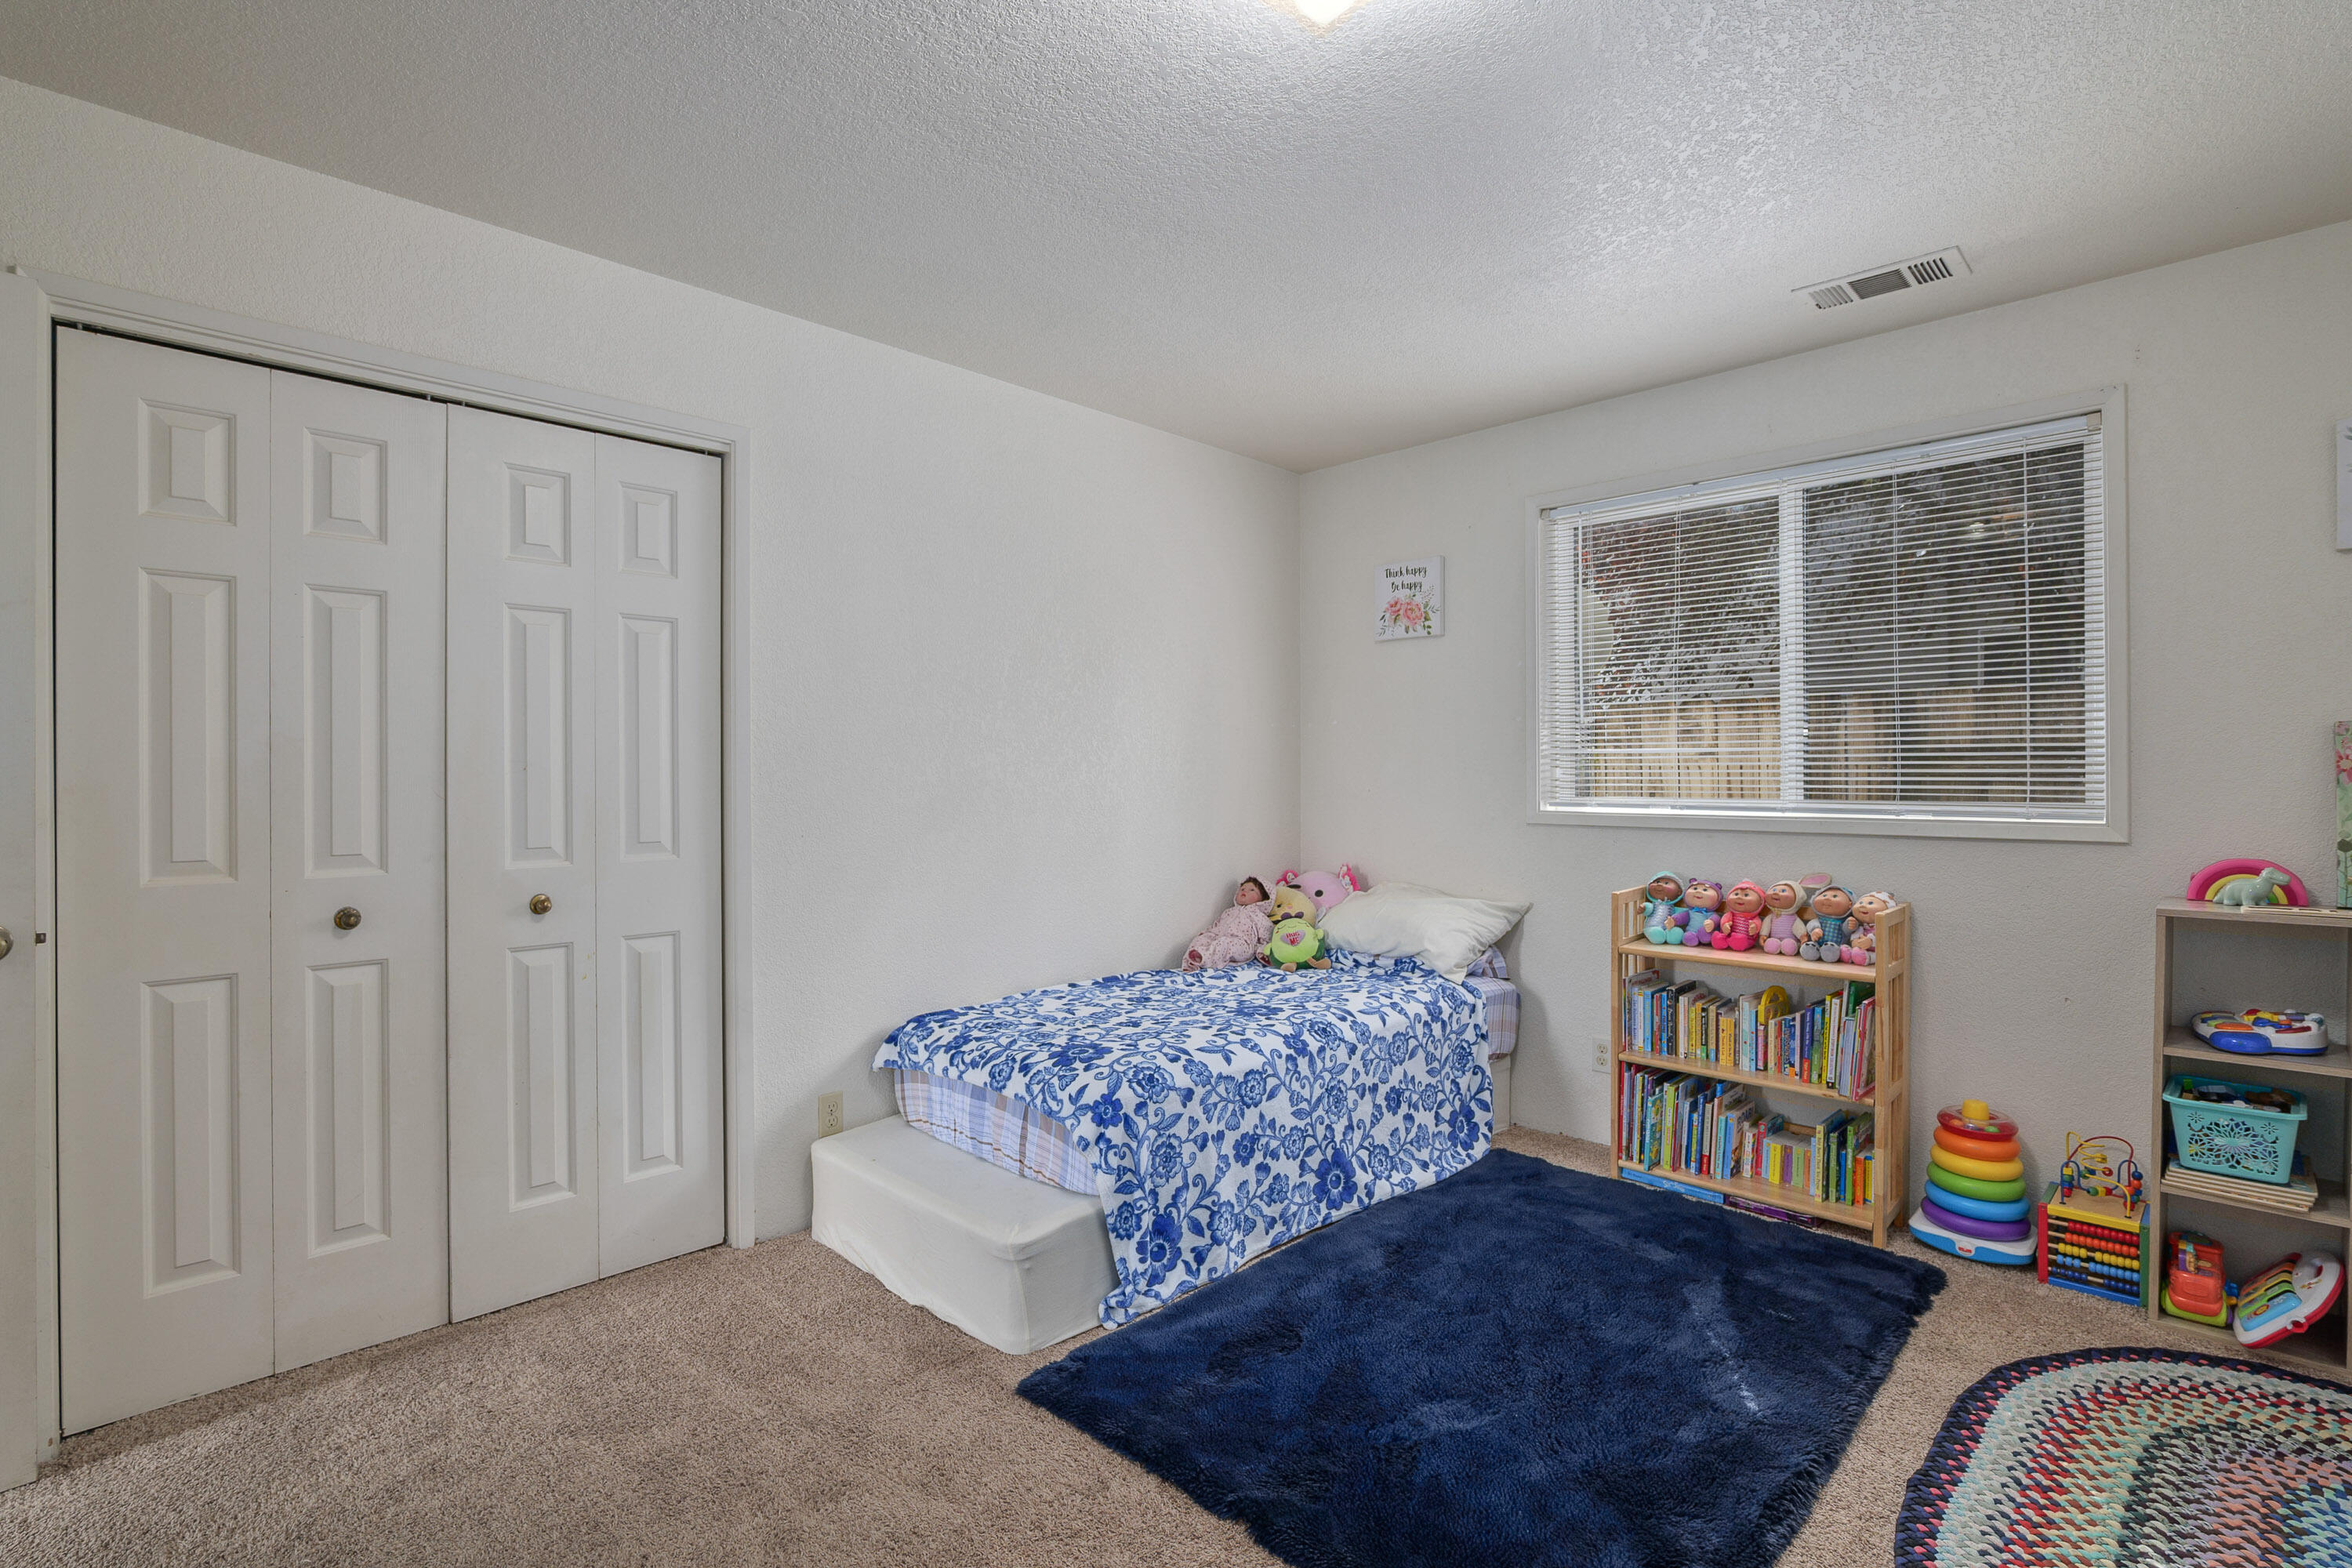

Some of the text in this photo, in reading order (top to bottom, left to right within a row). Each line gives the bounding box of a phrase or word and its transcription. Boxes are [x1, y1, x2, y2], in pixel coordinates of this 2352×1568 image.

[1385, 565, 1427, 579] Think happy
[1392, 580, 1422, 593] Be happy
[1290, 937, 1300, 946] ME
